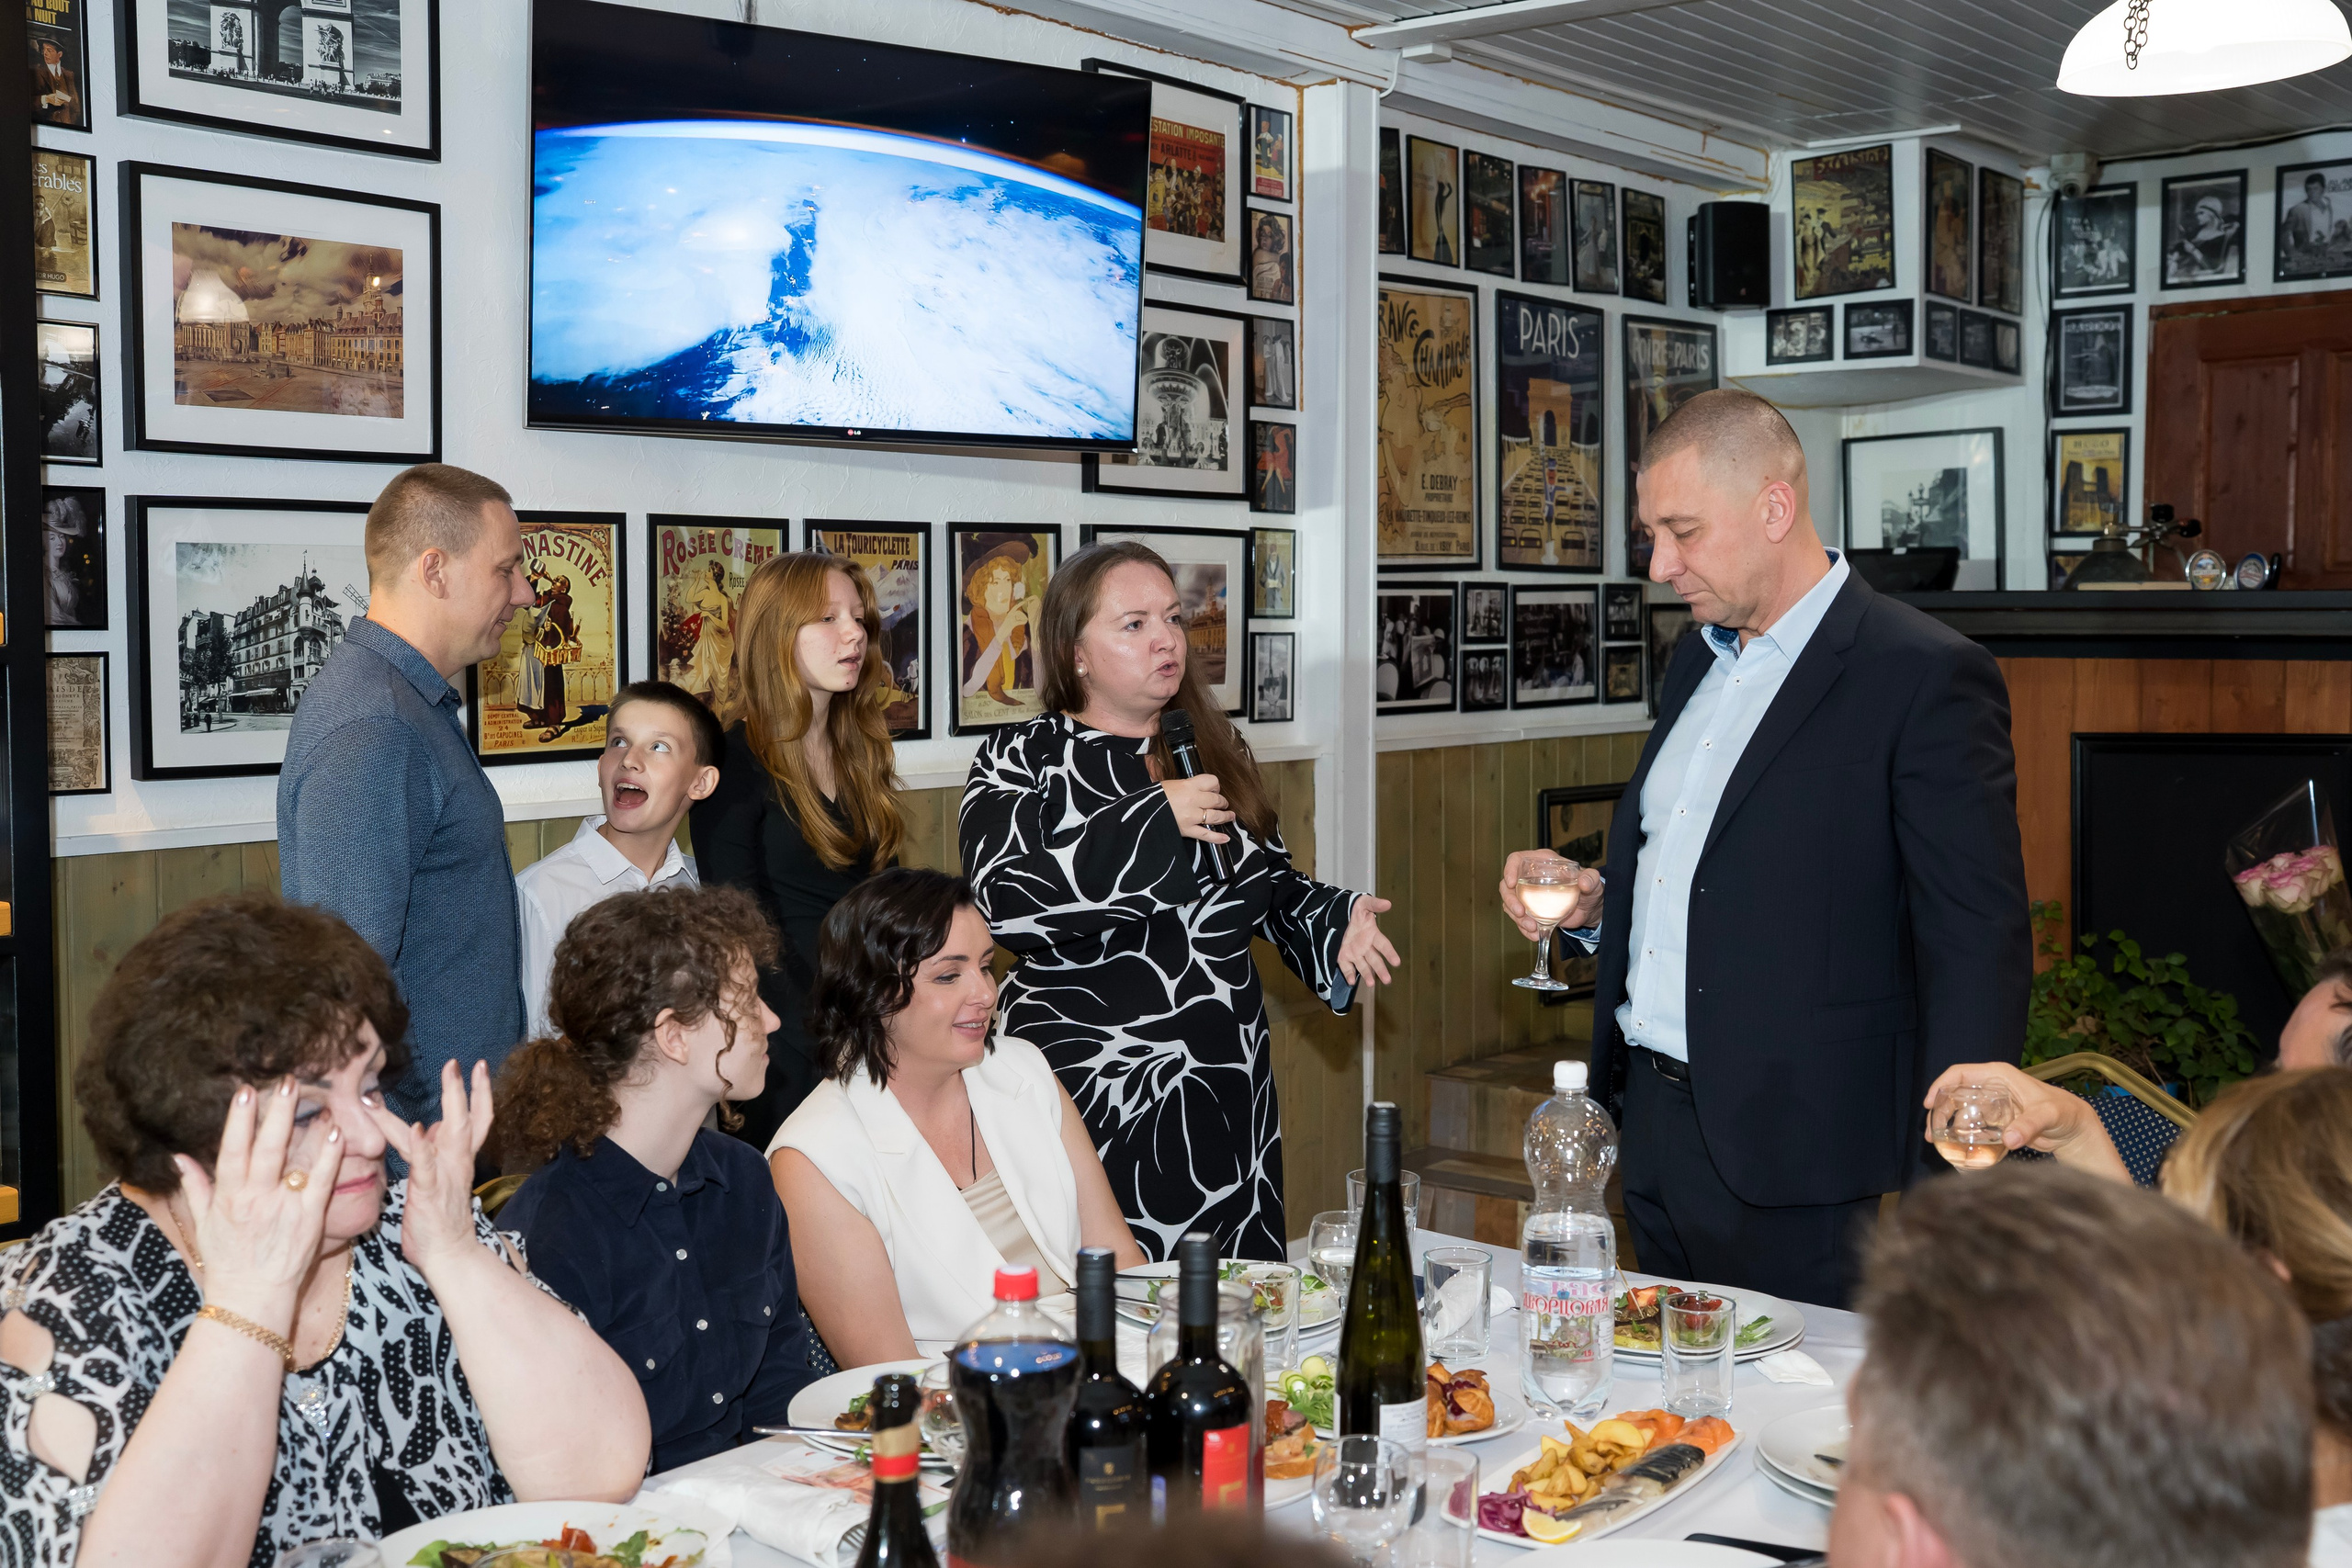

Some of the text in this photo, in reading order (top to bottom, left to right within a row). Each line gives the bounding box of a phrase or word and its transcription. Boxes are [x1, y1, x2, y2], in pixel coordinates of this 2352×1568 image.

[34, 8, 57, 25] NUIT
[1186, 127, 1226, 149] IMPOSANTE
[47, 273, 65, 281] HUGO
[1520, 306, 1580, 359] PARIS
[1413, 329, 1470, 389] CHAMPAGNE
[1674, 341, 1710, 371] PARIS
[833, 533, 910, 558] LA TOURICYCLETTE
[891, 558, 919, 570] PARIS
[993, 707, 1010, 716] CENT
[495, 730, 523, 739] CAPUCINES
[493, 739, 514, 748] PARIS
